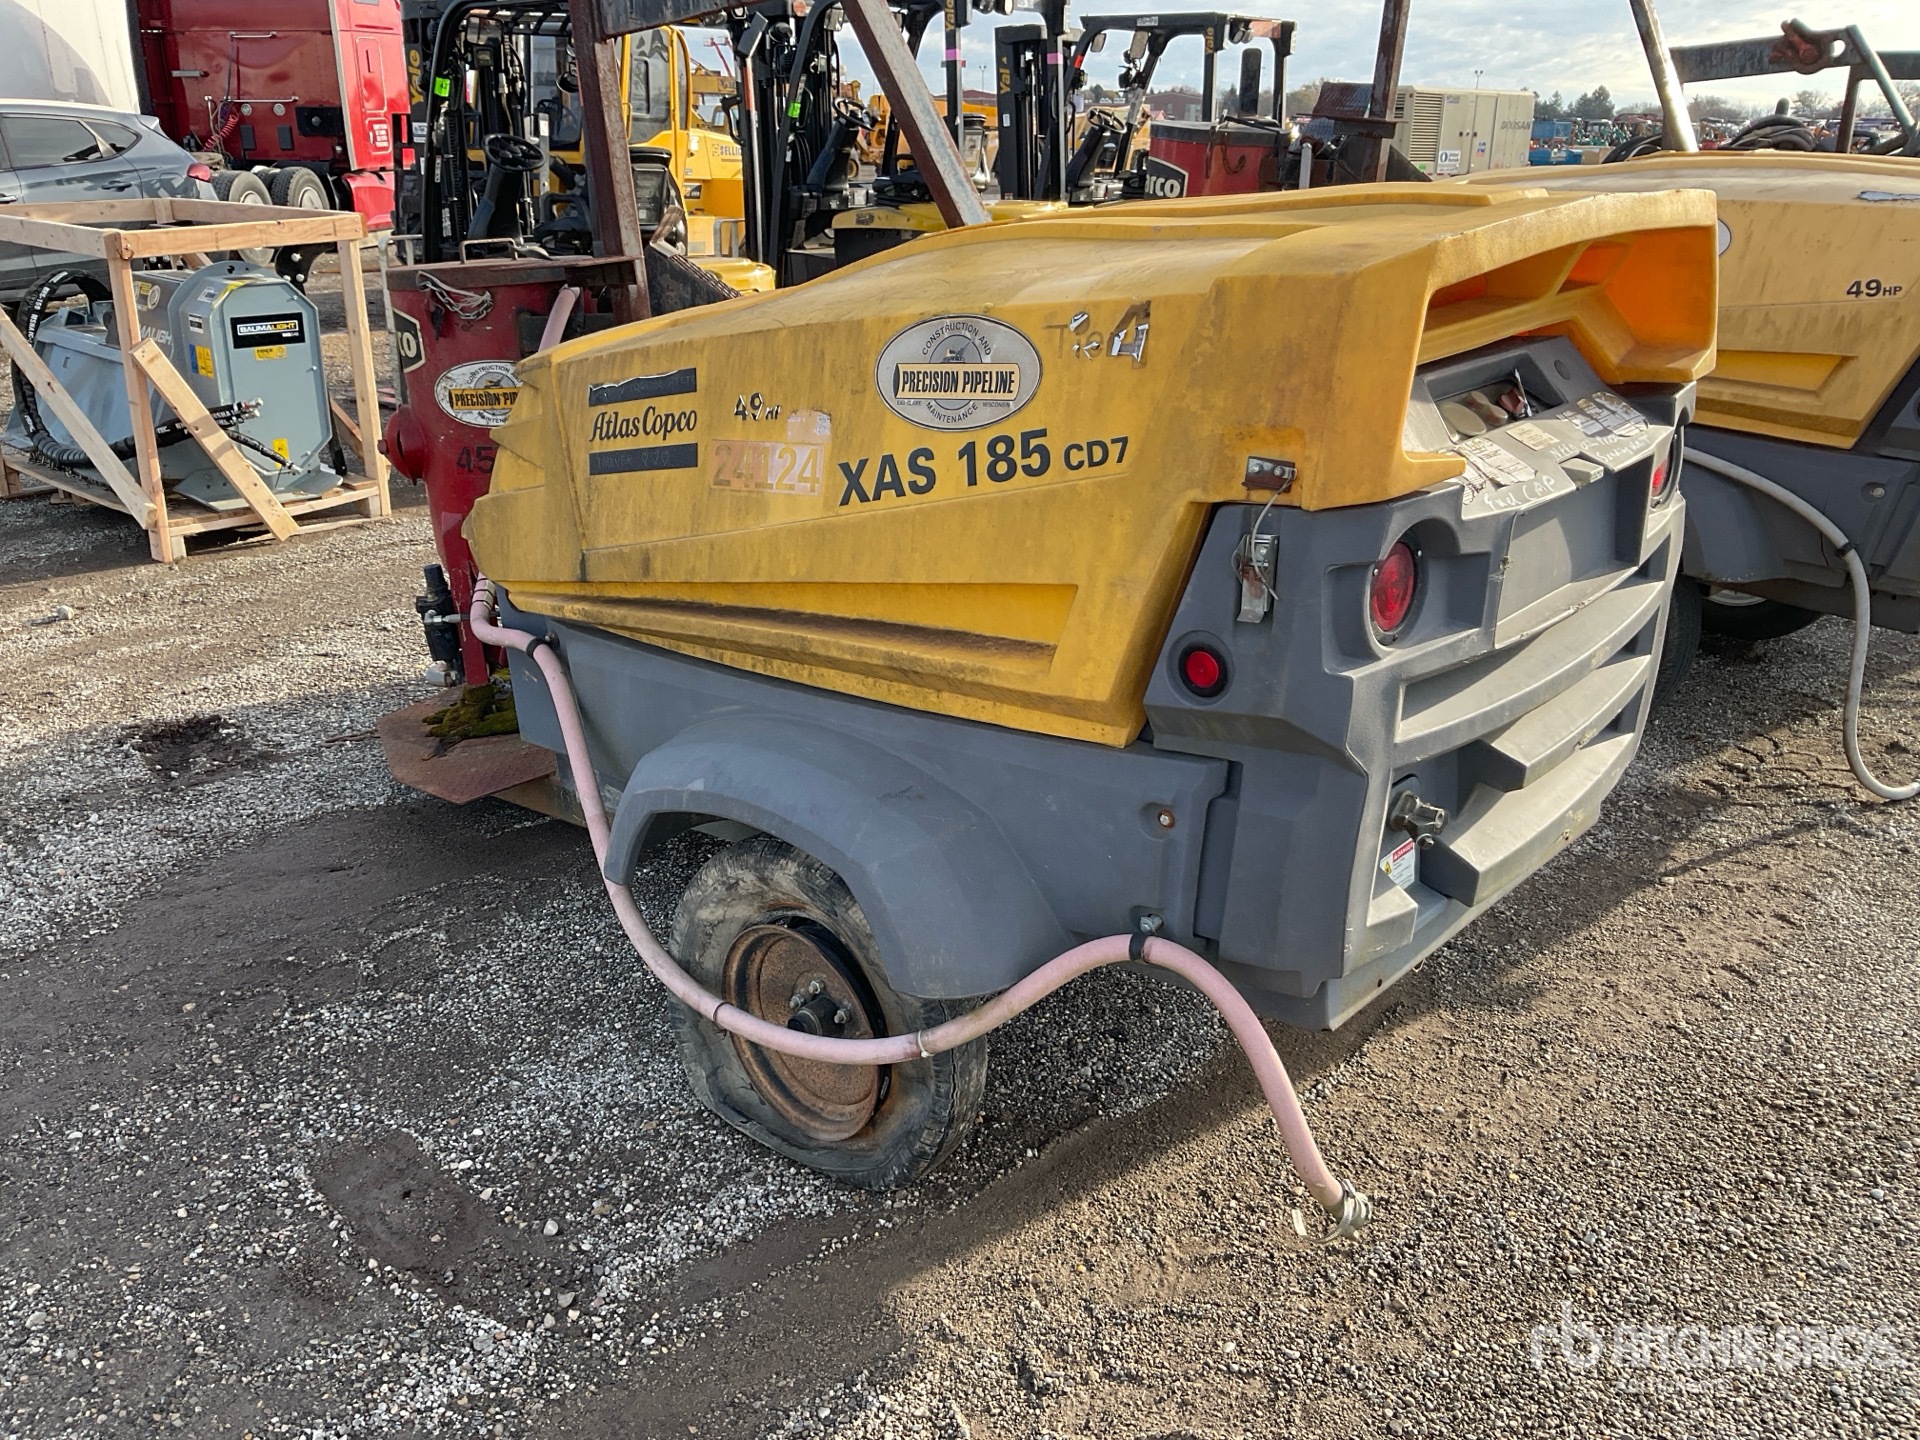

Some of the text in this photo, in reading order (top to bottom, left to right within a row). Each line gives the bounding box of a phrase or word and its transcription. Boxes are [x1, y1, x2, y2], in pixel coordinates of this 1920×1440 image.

[1206, 26, 1214, 54] Yale
[408, 49, 424, 105] Yale
[240, 323, 296, 333] BAUMALIGHT
[922, 321, 992, 356] CONSTRUCTION AND
[901, 370, 1015, 393] PRECISION PIPELINE
[453, 393, 501, 407] PRECISION
[926, 401, 978, 423] MAINTENANCE
[589, 405, 697, 442] Atlas Copco
[712, 444, 820, 493] 24124
[838, 428, 1128, 507] XAS 185 CD7
